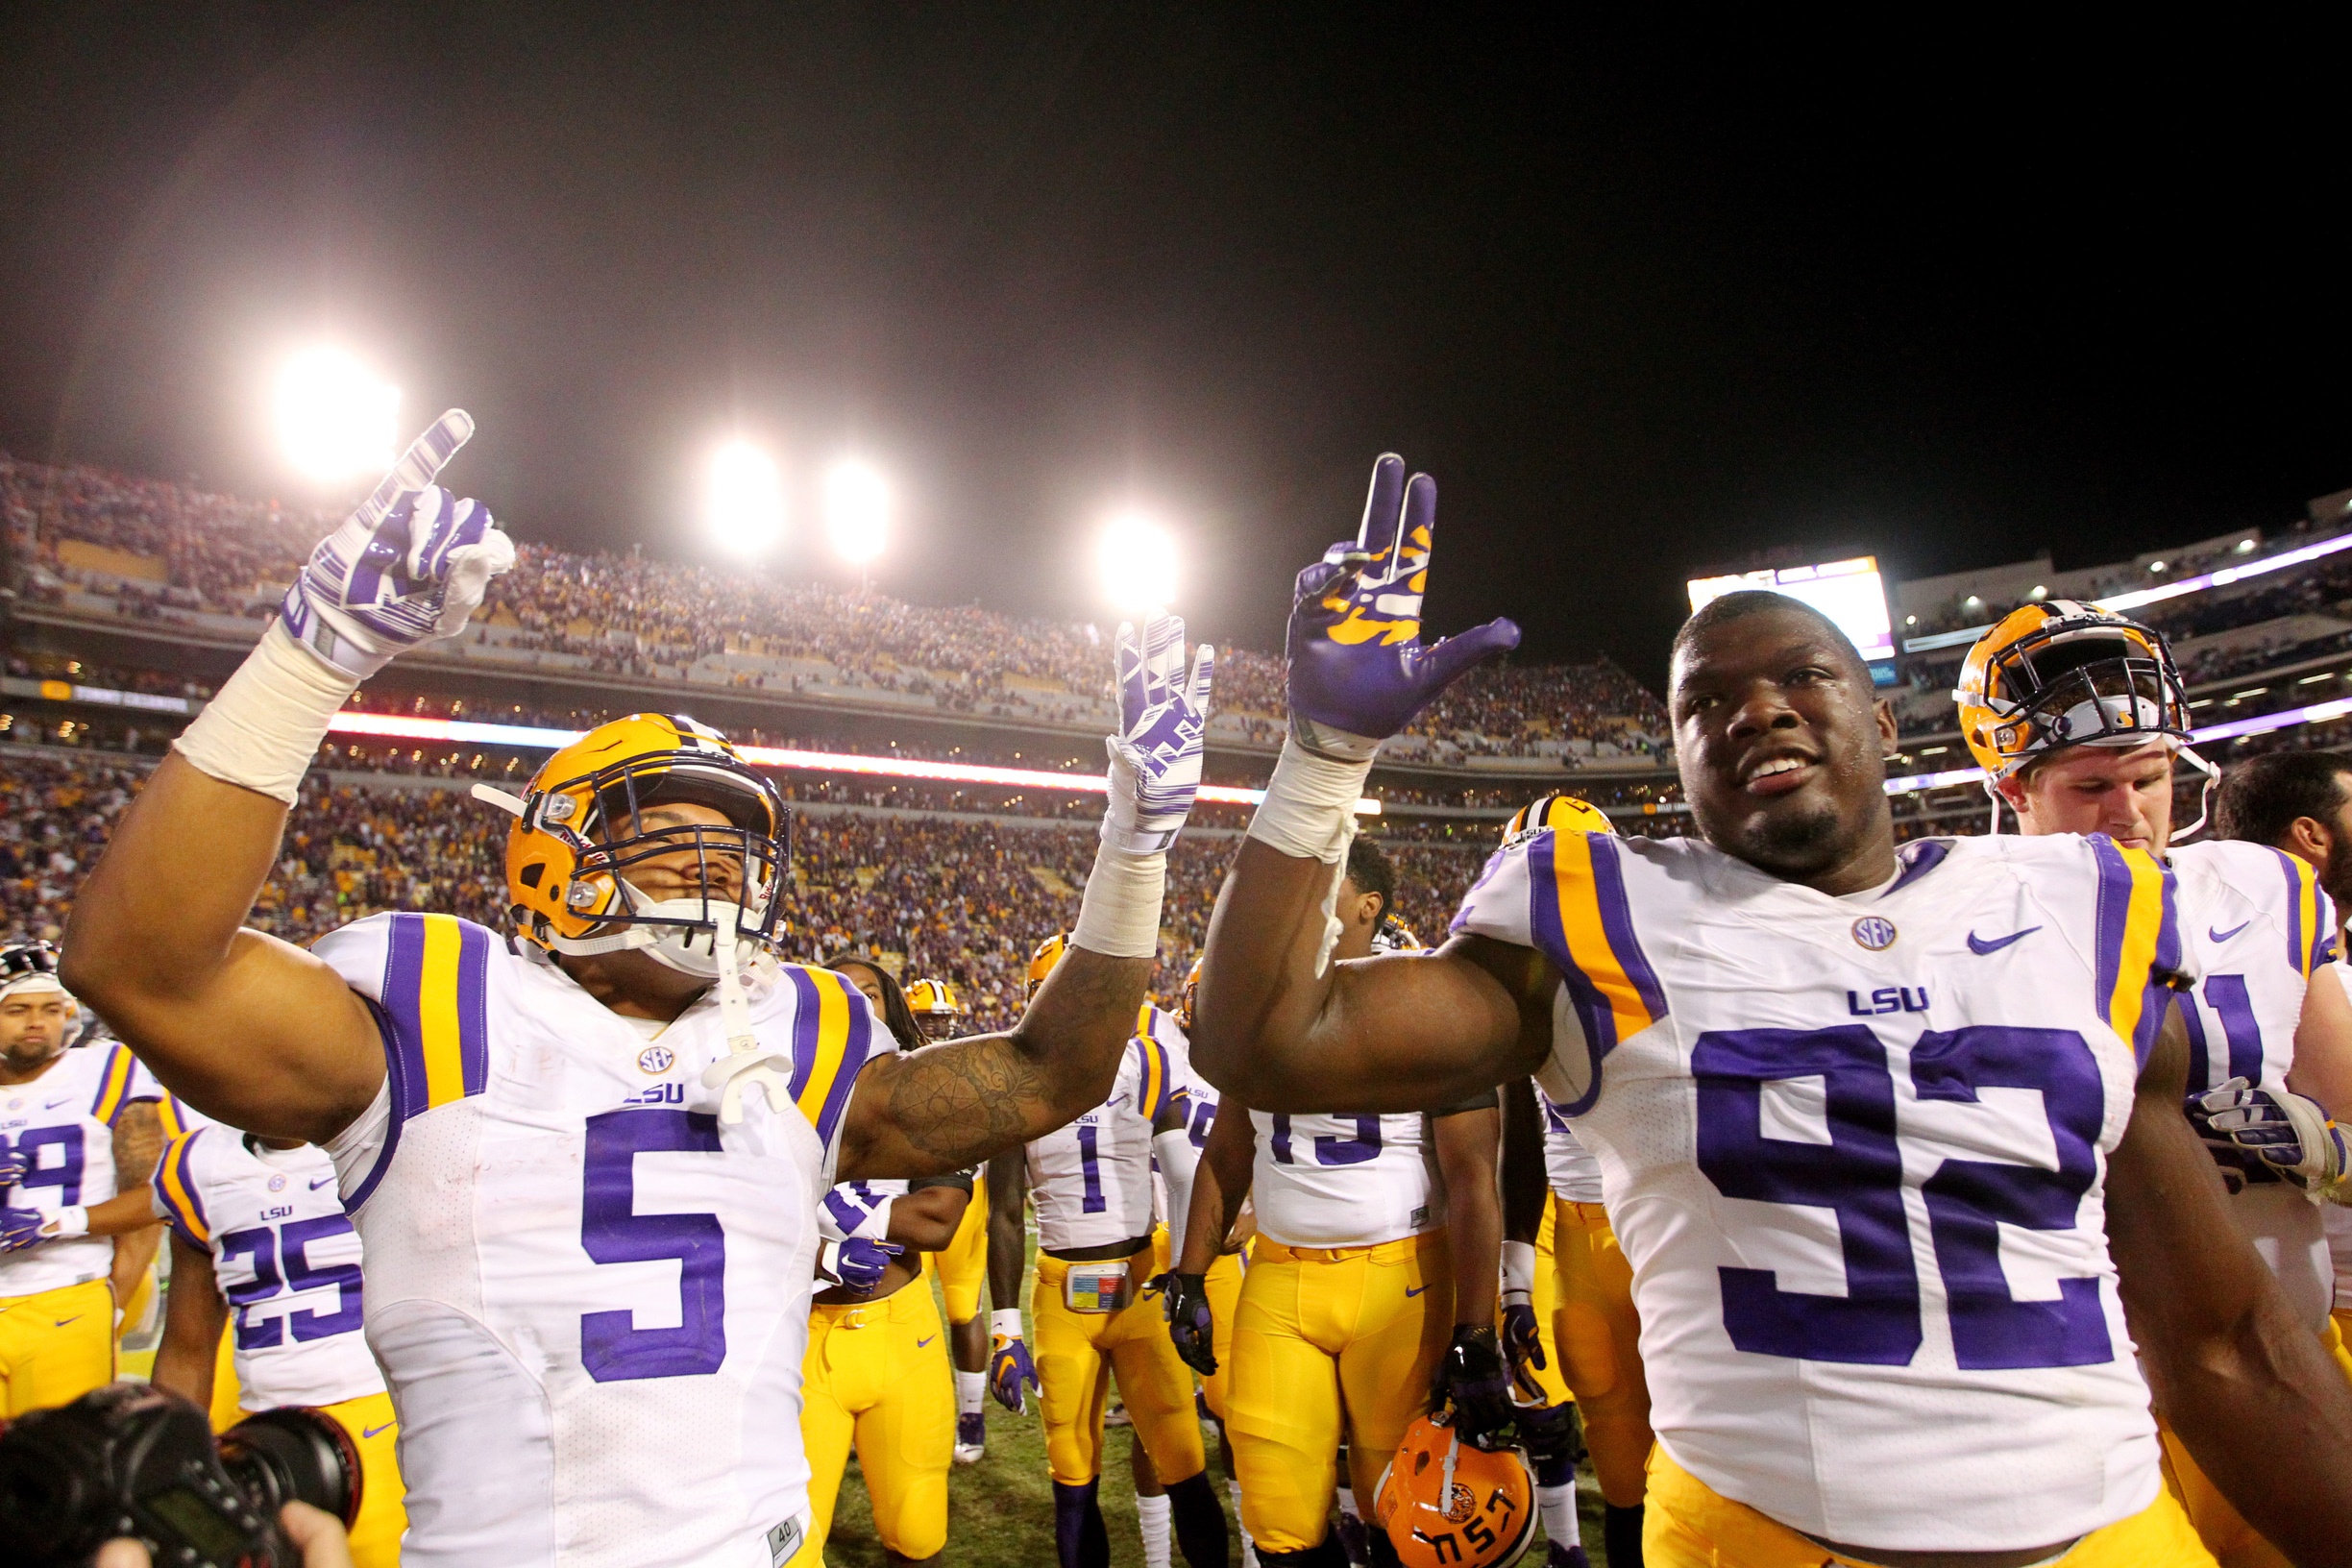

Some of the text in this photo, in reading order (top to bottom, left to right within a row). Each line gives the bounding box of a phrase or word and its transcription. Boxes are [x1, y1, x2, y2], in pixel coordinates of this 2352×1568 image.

[1854, 917, 1896, 950] SEC
[1847, 986, 1929, 1016] LSU
[639, 1047, 674, 1073] SEC
[1188, 1088, 1209, 1099] LSU
[1077, 1125, 1107, 1213] 1
[260, 1205, 293, 1221] LSU
[1691, 1024, 2116, 1371] 92
[581, 1108, 726, 1384] 5
[220, 1213, 364, 1351] 25
[778, 1521, 792, 1543] 40
[1432, 1489, 1517, 1565] LSU
